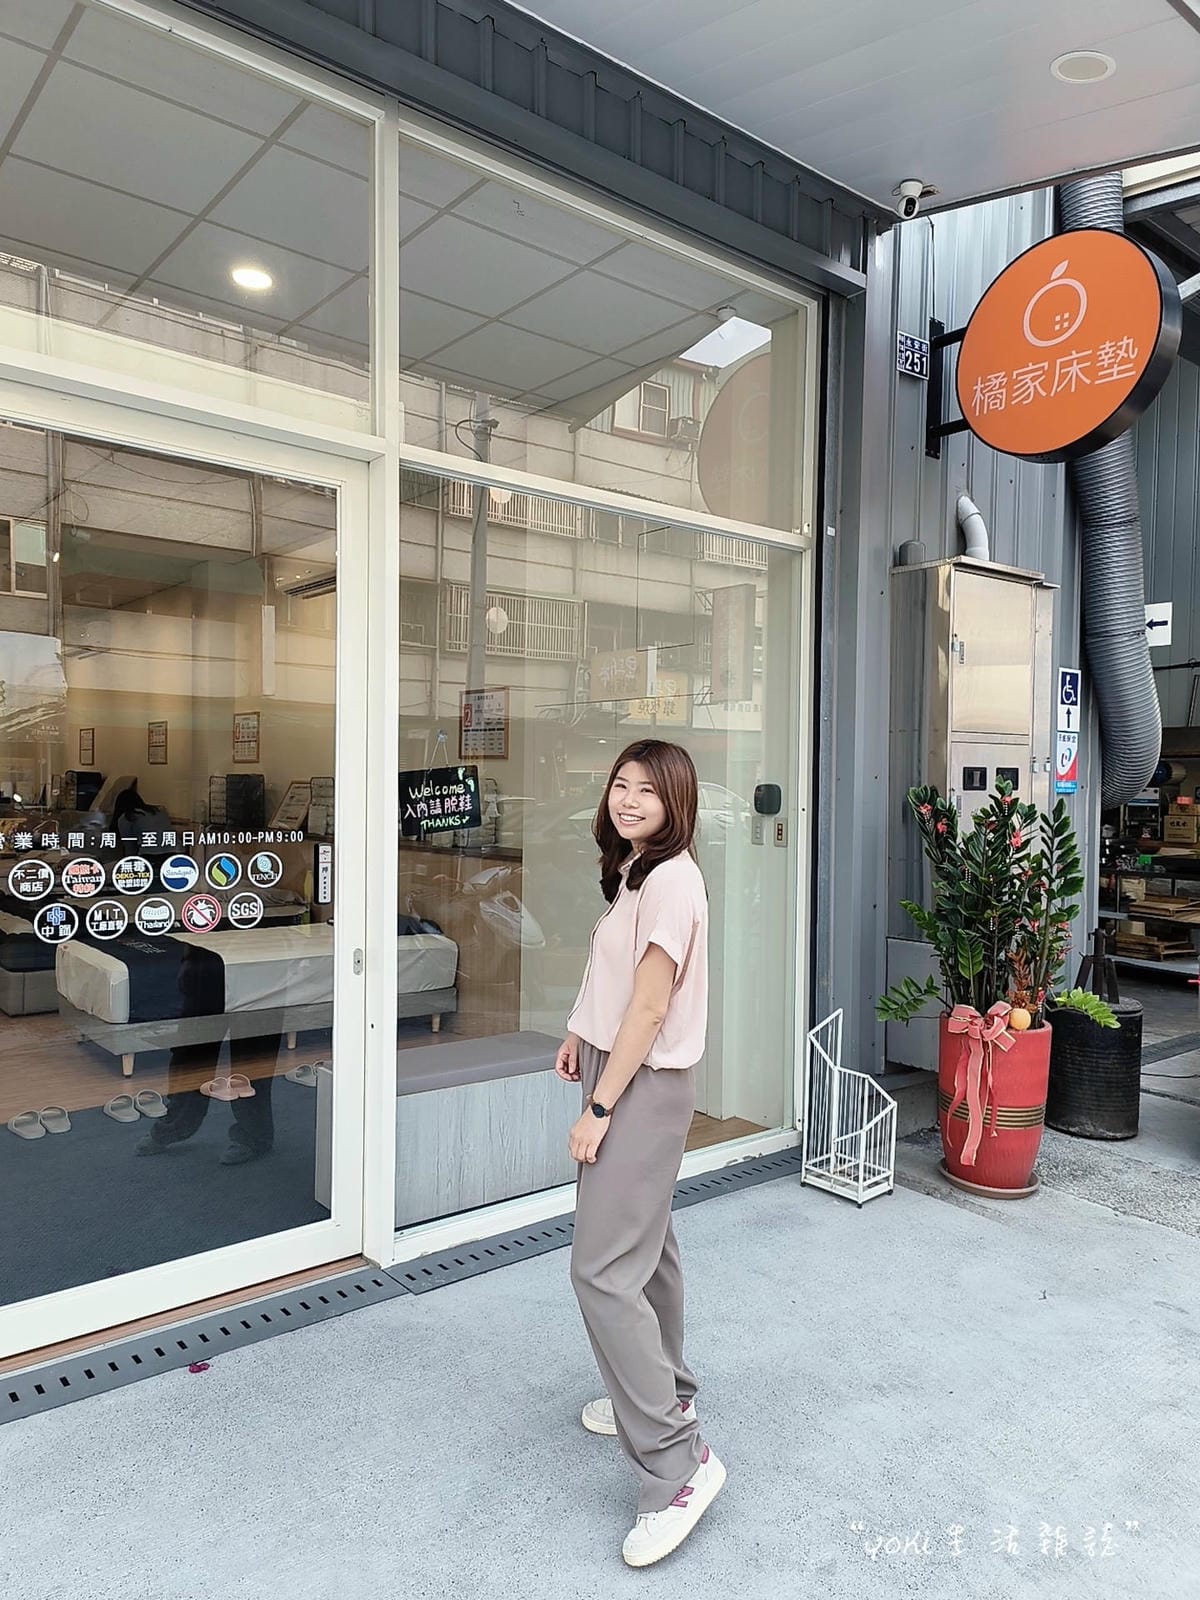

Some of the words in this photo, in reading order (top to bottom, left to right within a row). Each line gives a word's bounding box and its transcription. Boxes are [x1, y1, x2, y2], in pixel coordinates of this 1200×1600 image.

[905, 350, 927, 375] 251
[970, 335, 1138, 416] 橘家床墊
[408, 780, 466, 799] Welcome
[420, 816, 462, 831] THANKS
[20, 881, 43, 893] 商店
[231, 902, 258, 917] SGS
